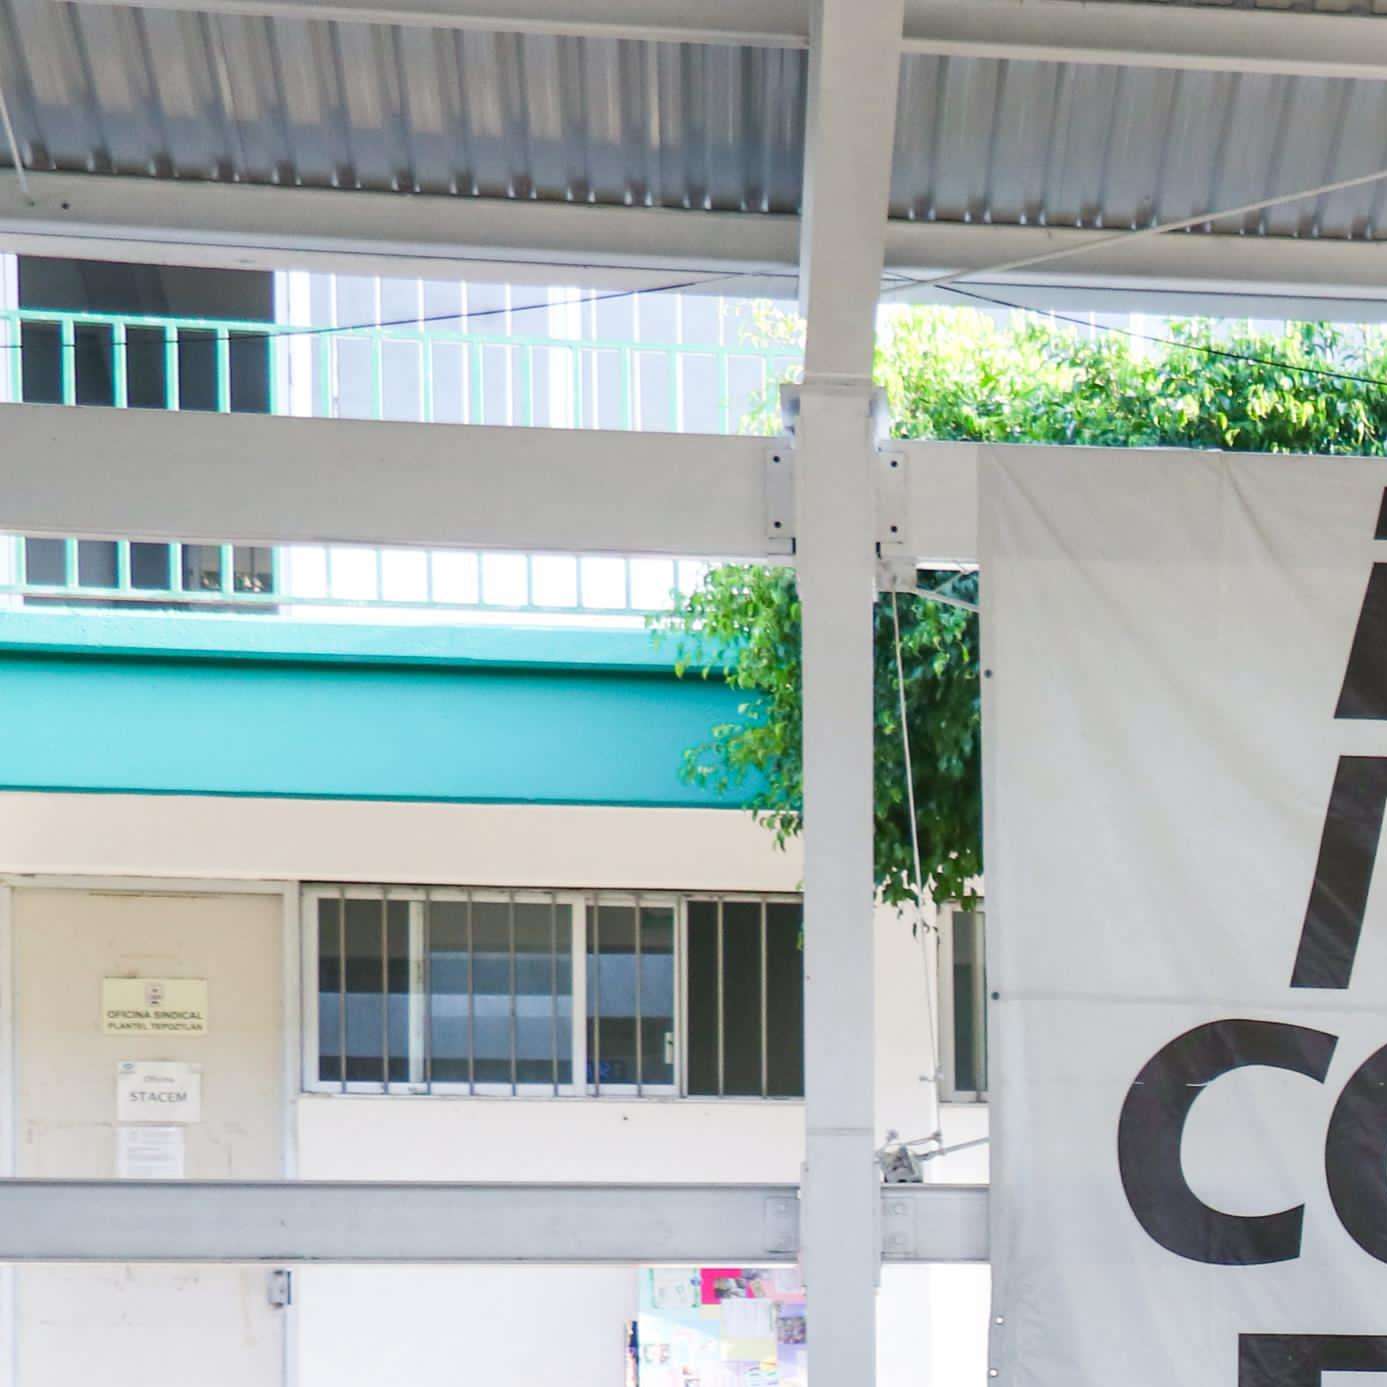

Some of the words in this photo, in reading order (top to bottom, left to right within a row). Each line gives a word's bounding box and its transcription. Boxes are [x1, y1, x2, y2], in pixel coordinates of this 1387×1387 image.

[106, 1010, 151, 1019] OFICINA
[153, 1011, 204, 1020] SINDICAL
[107, 1022, 151, 1031] PLANTEL
[128, 1091, 187, 1102] STACEM
